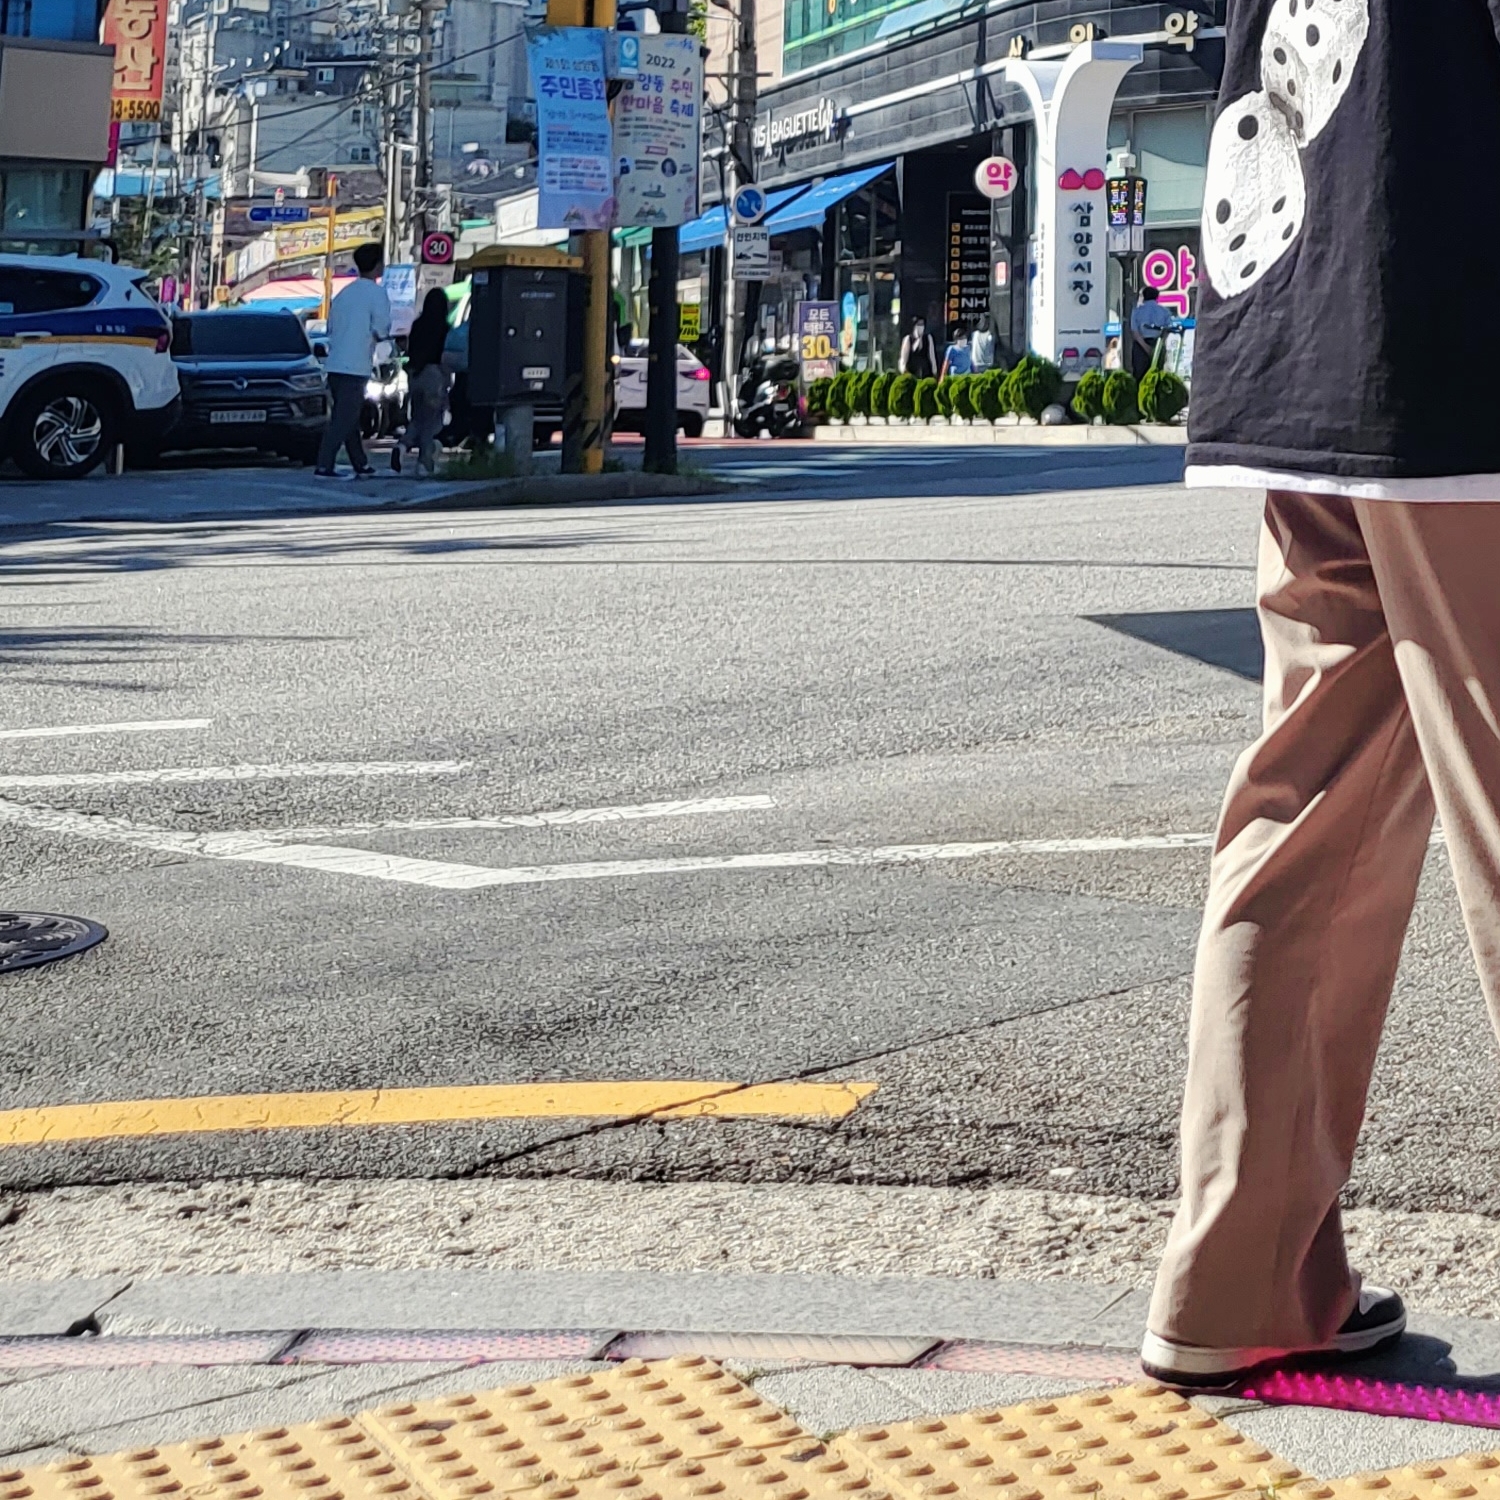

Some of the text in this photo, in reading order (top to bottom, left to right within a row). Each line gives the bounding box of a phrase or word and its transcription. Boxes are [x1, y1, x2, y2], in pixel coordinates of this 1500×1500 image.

[645, 52, 677, 69] 2022
[669, 78, 695, 99] 주민
[620, 93, 695, 118] 한마음 축제
[770, 109, 818, 144] BAGUETTE
[985, 162, 1013, 192] 약
[429, 240, 448, 256] 30
[1071, 201, 1095, 306] 삼양시장
[1143, 246, 1198, 318] 약
[961, 296, 987, 309] NH
[808, 308, 830, 322] 모든
